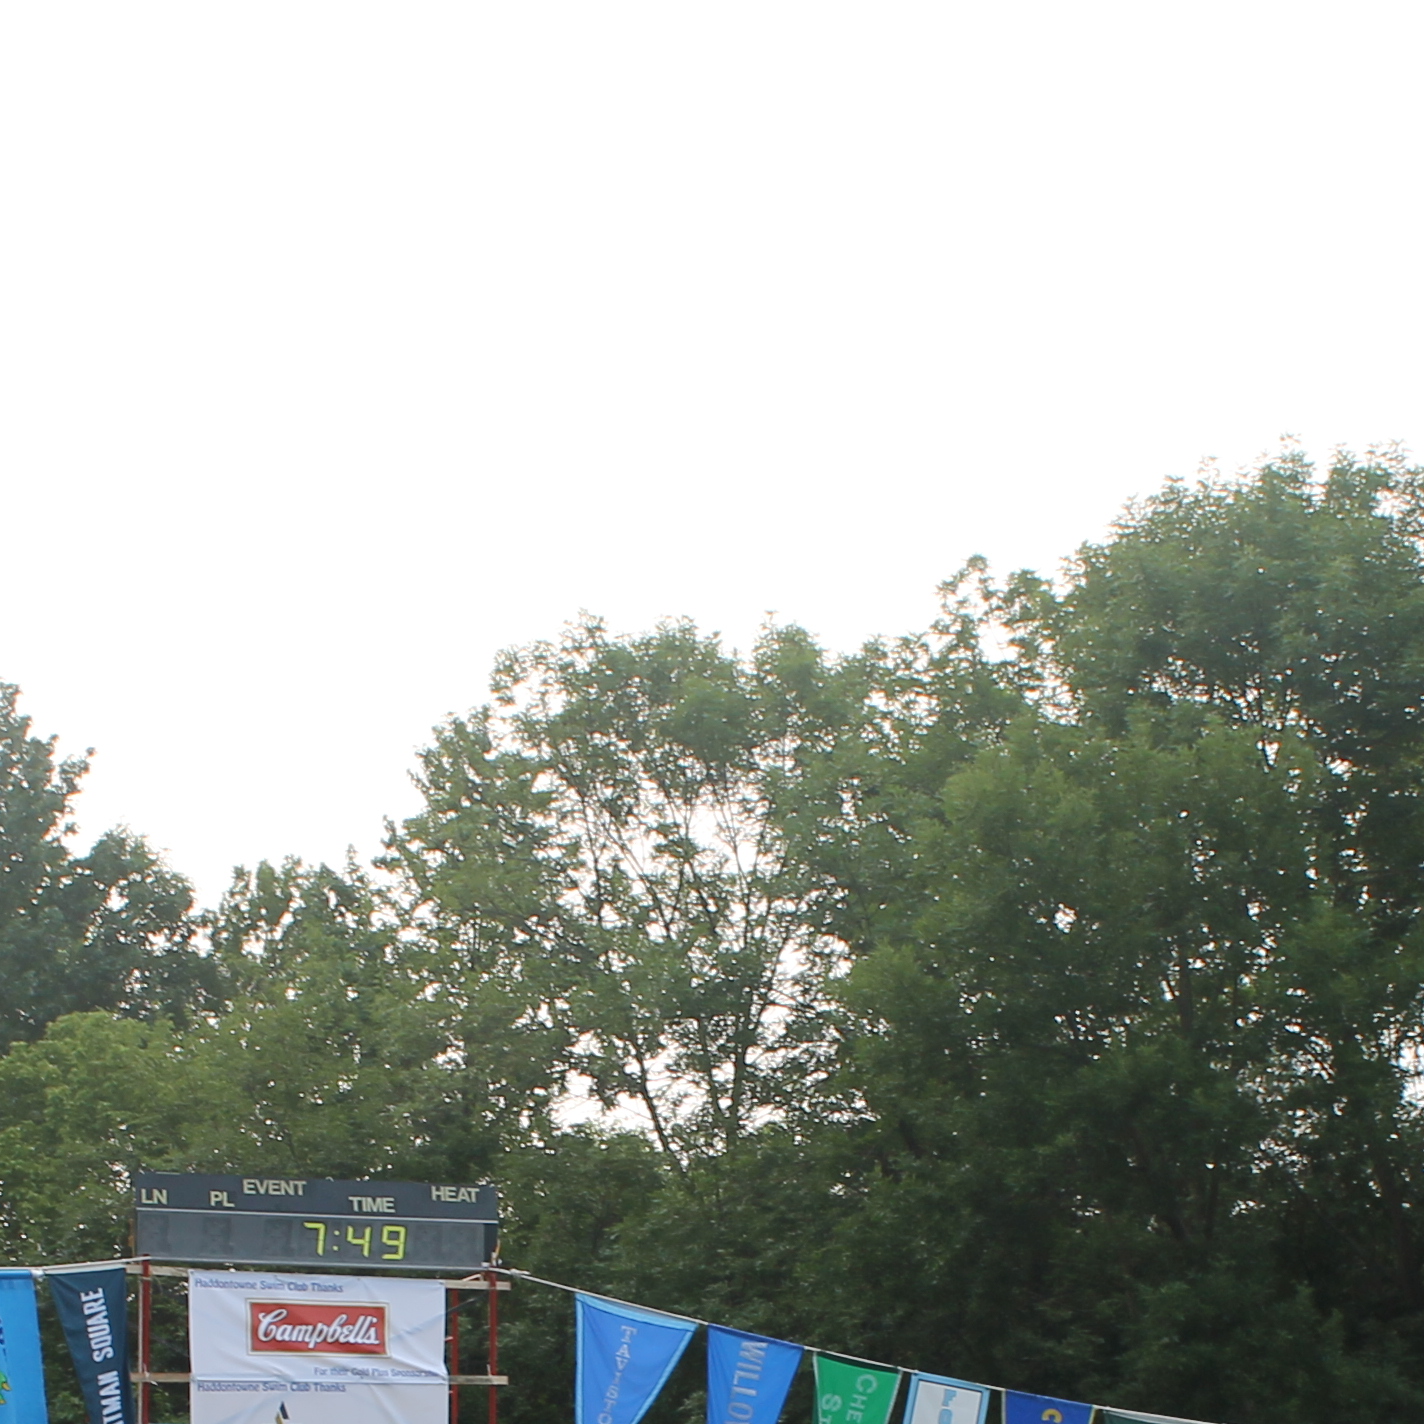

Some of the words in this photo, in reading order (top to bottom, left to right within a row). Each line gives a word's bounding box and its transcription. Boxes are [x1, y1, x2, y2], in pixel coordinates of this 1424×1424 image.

[141, 1188, 167, 1205] LN
[210, 1190, 235, 1207] PL
[242, 1179, 307, 1196] EVENT
[348, 1196, 395, 1213] TIME
[431, 1186, 480, 1203] HEAT
[303, 1221, 407, 1261] 7:49
[287, 1280, 309, 1292] Club
[311, 1280, 343, 1293] Thanks
[80, 1287, 114, 1363] SQUARE
[371, 1368, 388, 1378] Plus
[290, 1382, 311, 1392] Club
[313, 1382, 346, 1393] Thanks
